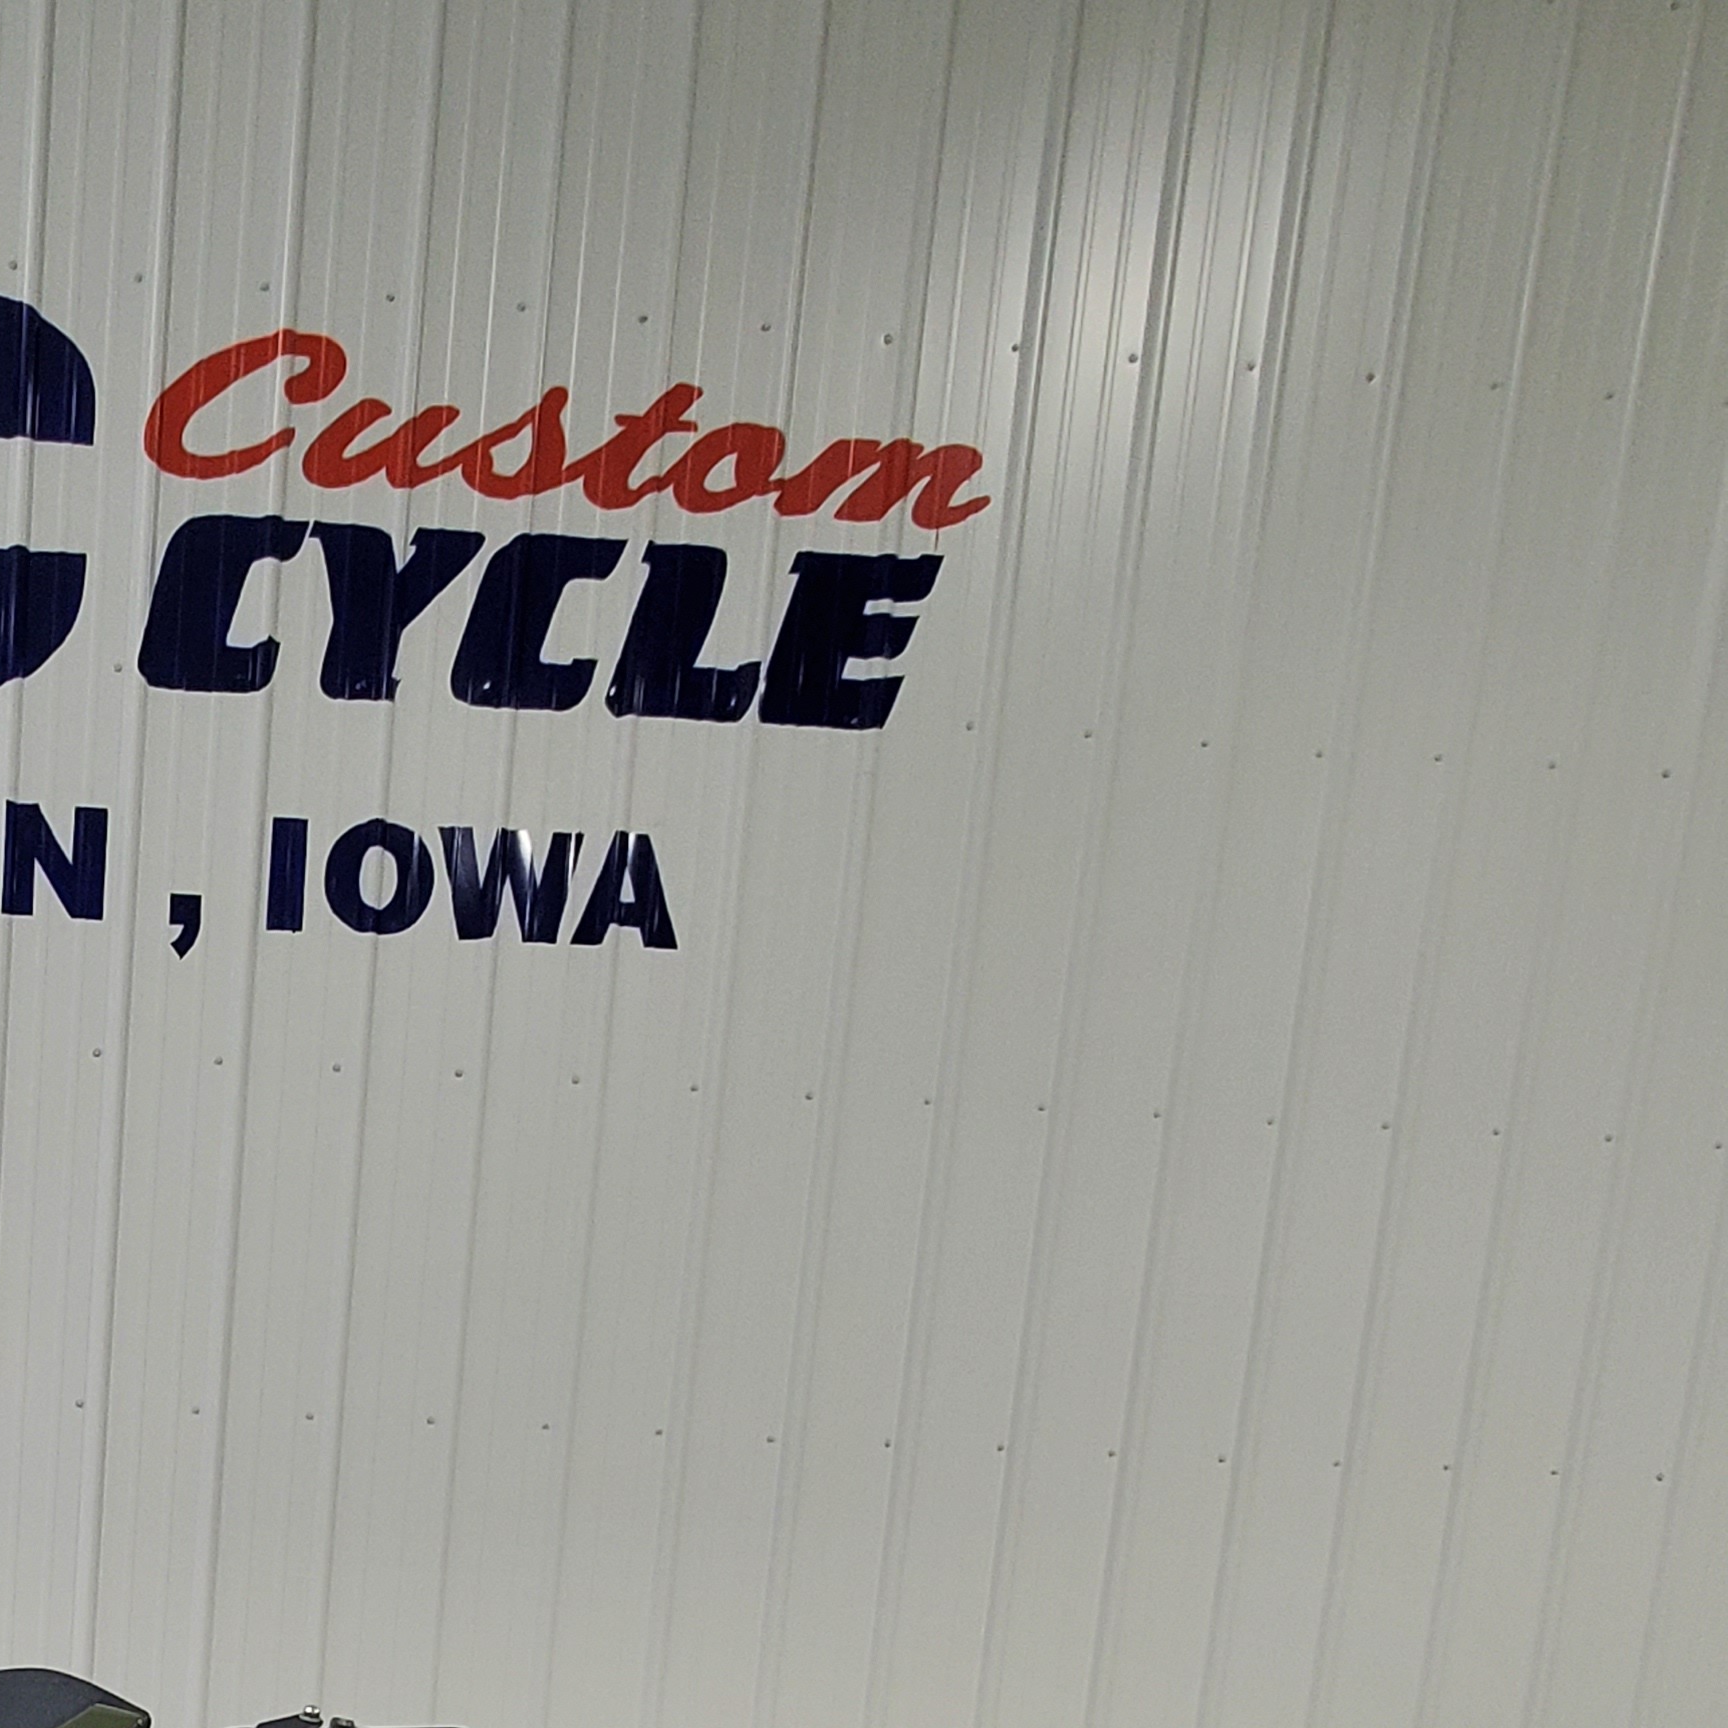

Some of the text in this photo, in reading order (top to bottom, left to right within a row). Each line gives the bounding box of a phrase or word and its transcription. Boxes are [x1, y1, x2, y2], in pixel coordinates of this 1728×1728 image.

[144, 329, 989, 530] Custom
[136, 513, 946, 731] CYCLE
[265, 816, 679, 950] IOWA
